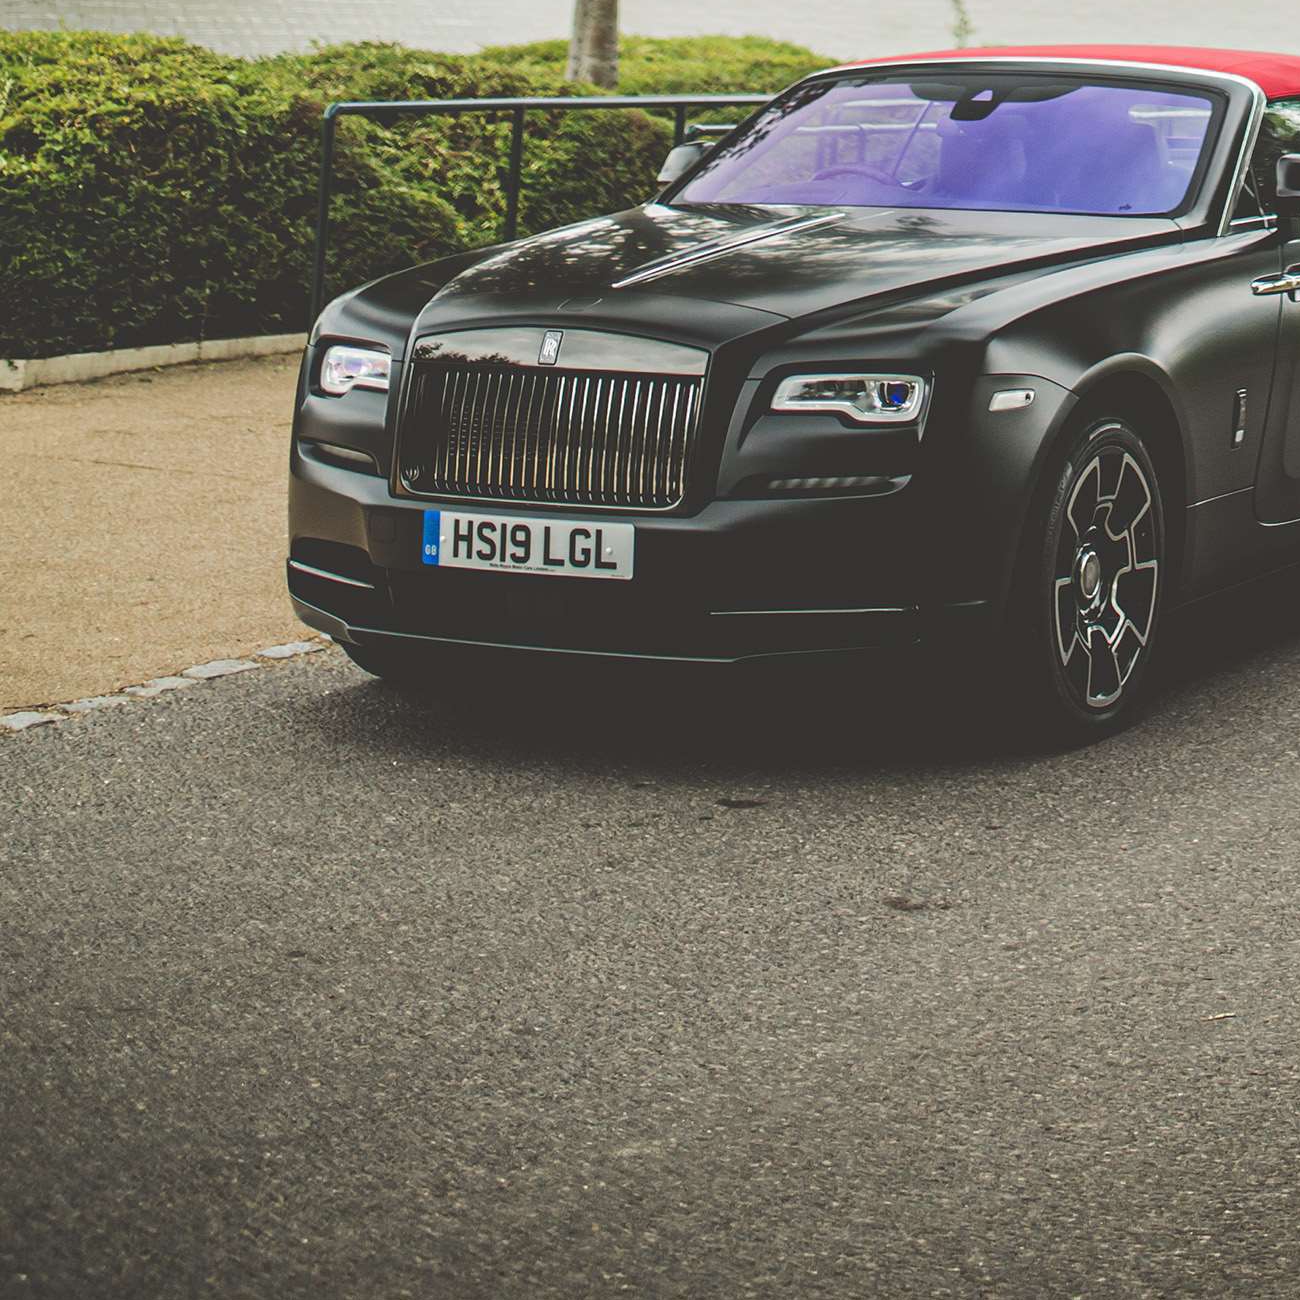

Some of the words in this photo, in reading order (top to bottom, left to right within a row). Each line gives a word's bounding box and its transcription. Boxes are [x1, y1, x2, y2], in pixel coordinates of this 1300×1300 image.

[424, 544, 437, 556] GB
[452, 519, 531, 564] HS19
[543, 526, 617, 570] LGL
